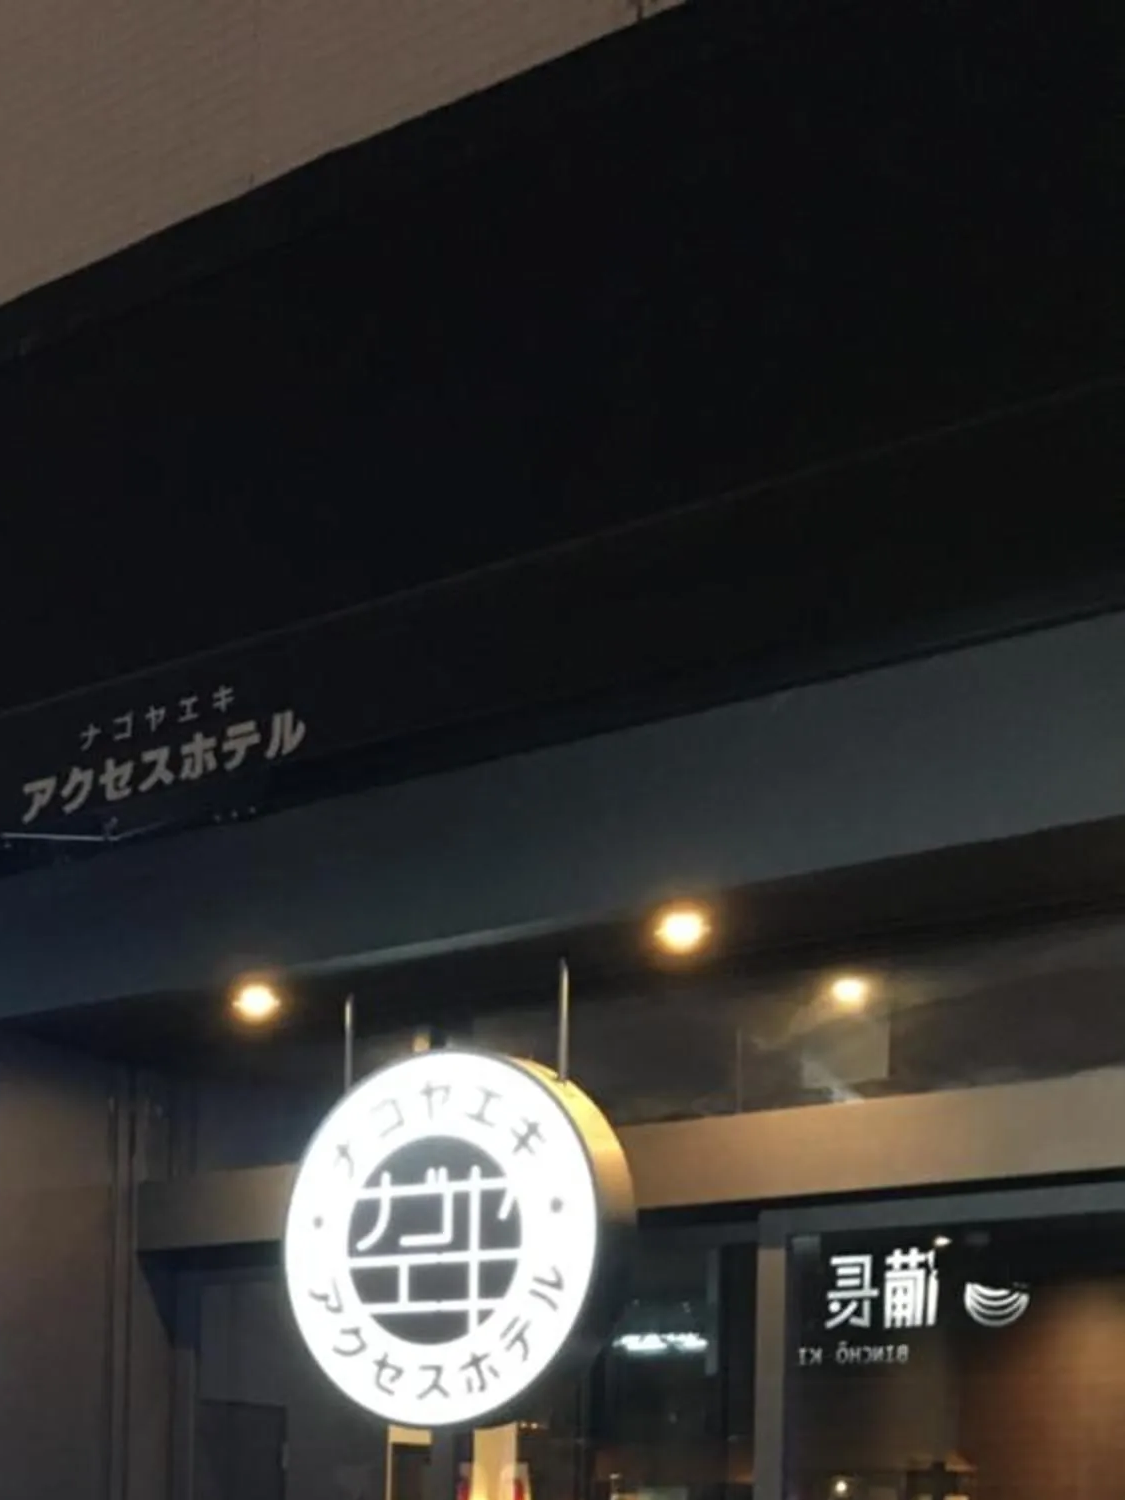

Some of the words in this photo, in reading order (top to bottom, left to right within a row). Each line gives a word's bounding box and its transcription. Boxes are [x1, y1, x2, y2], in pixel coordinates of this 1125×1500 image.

[22, 710, 306, 825] アクセスホテル
[308, 1264, 565, 1399] アクセスホテル
